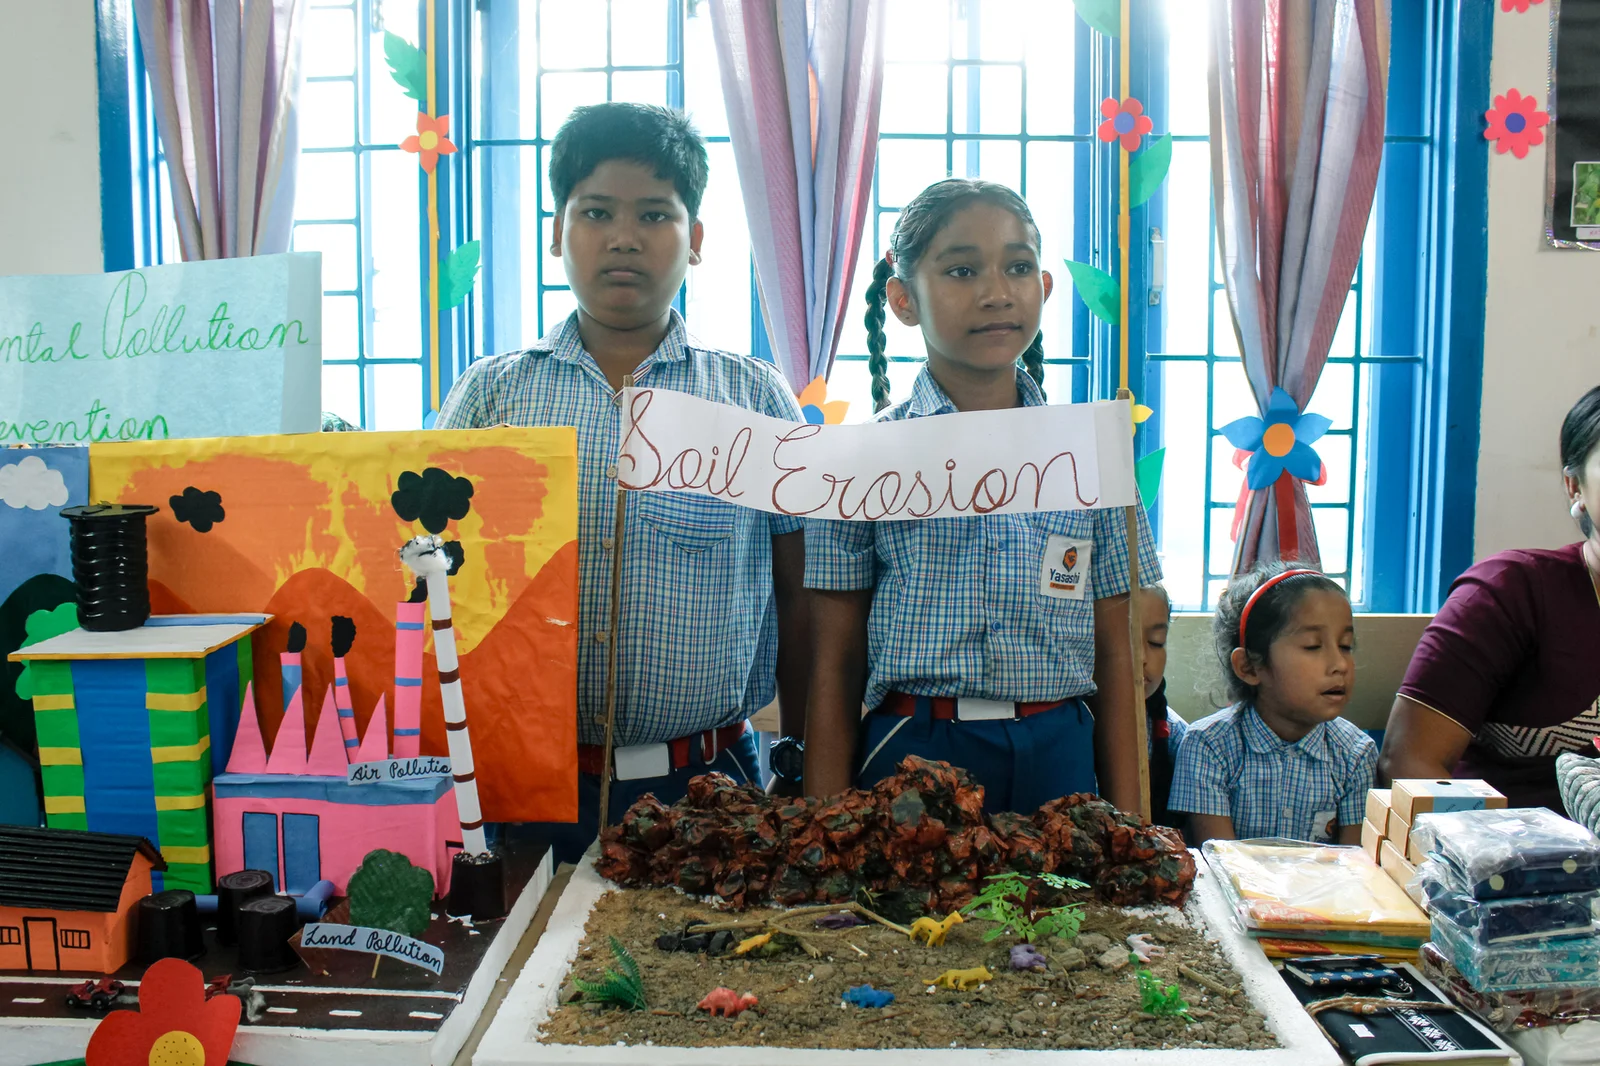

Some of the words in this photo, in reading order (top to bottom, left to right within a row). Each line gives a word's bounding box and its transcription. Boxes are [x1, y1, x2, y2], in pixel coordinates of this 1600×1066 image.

[102, 271, 309, 359] Pollution
[618, 389, 752, 499] Soil
[771, 424, 1099, 521] Erosion
[1049, 567, 1081, 585] Yasashi
[350, 764, 382, 781] Air
[389, 758, 452, 779] Pollutio
[304, 926, 357, 946] Land
[365, 930, 442, 972] Pollution
